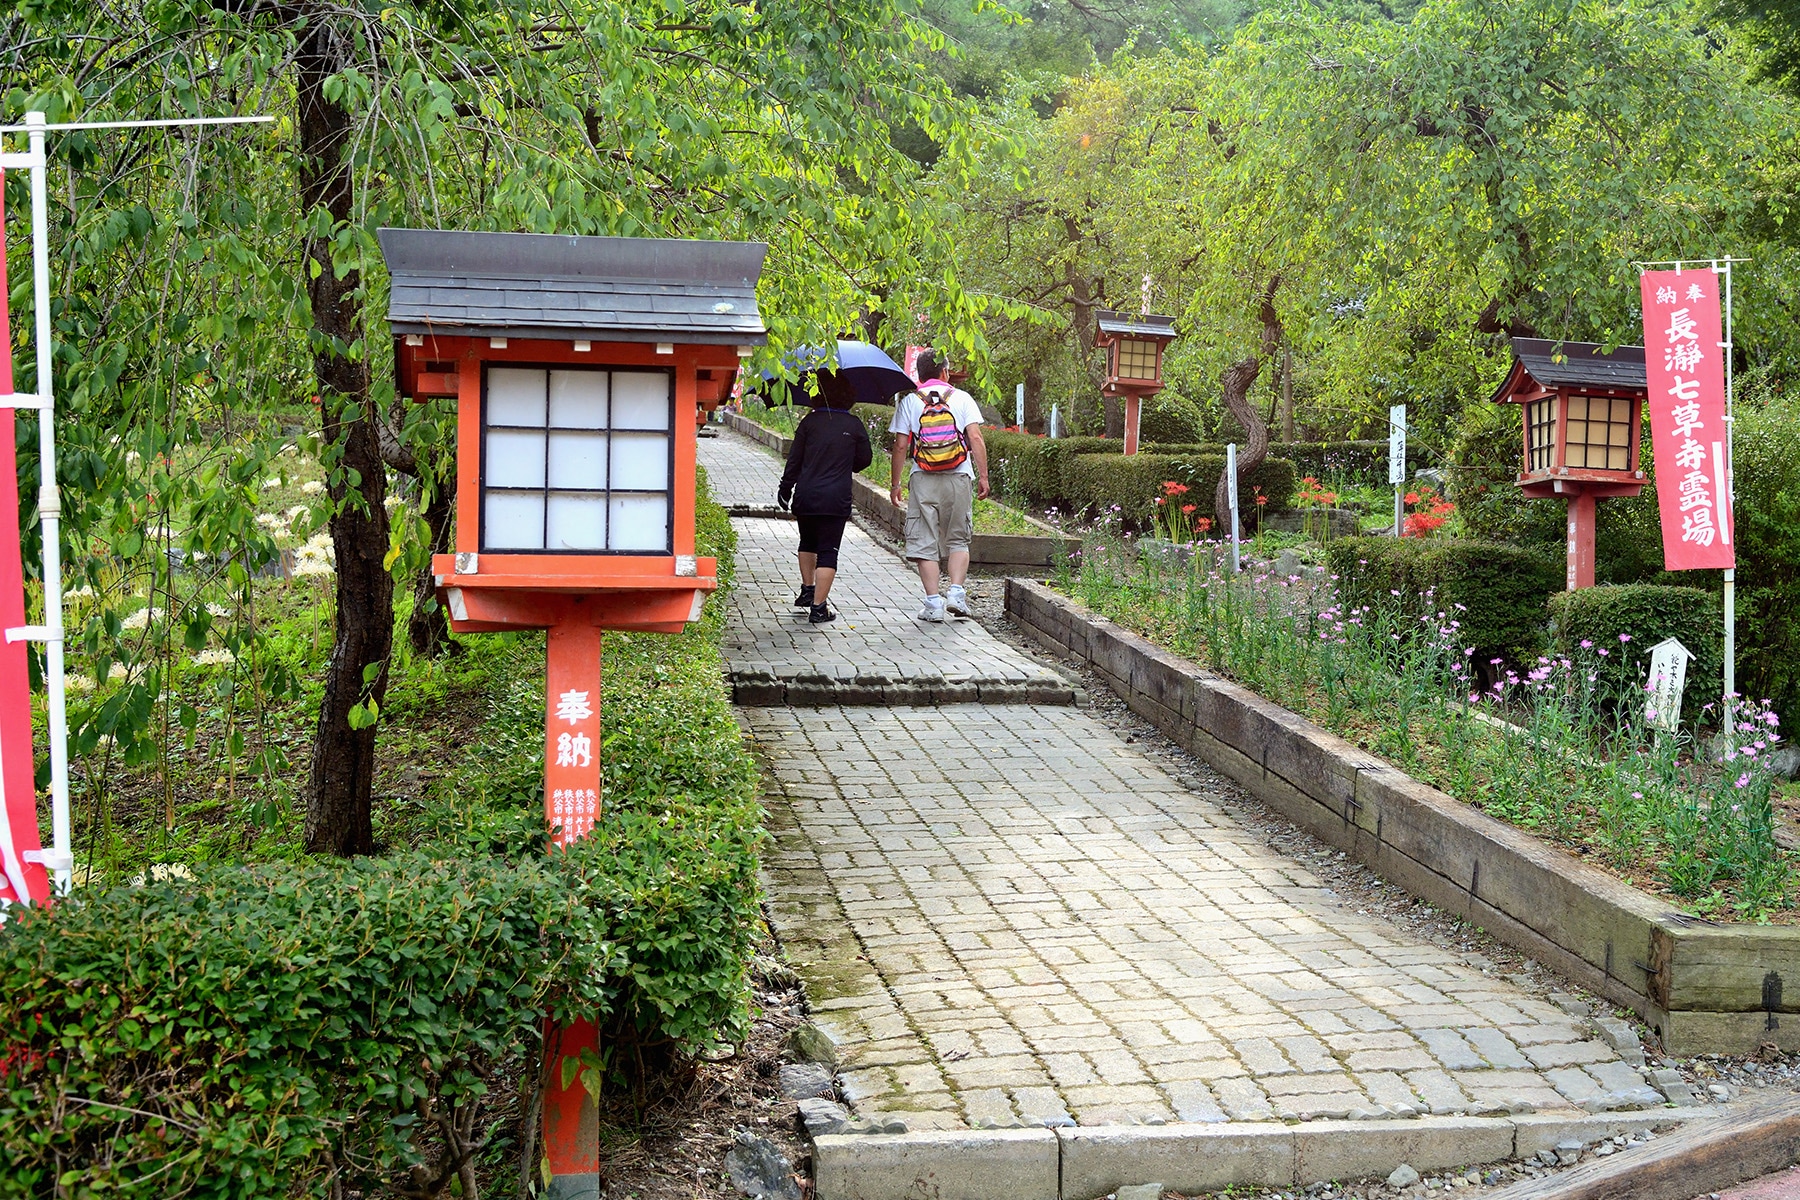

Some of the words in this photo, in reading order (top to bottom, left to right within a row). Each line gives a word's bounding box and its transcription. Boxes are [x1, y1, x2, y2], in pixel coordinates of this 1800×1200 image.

[1664, 308, 1716, 547] 長瀞七草寺霊場
[554, 688, 594, 767] 奉納
